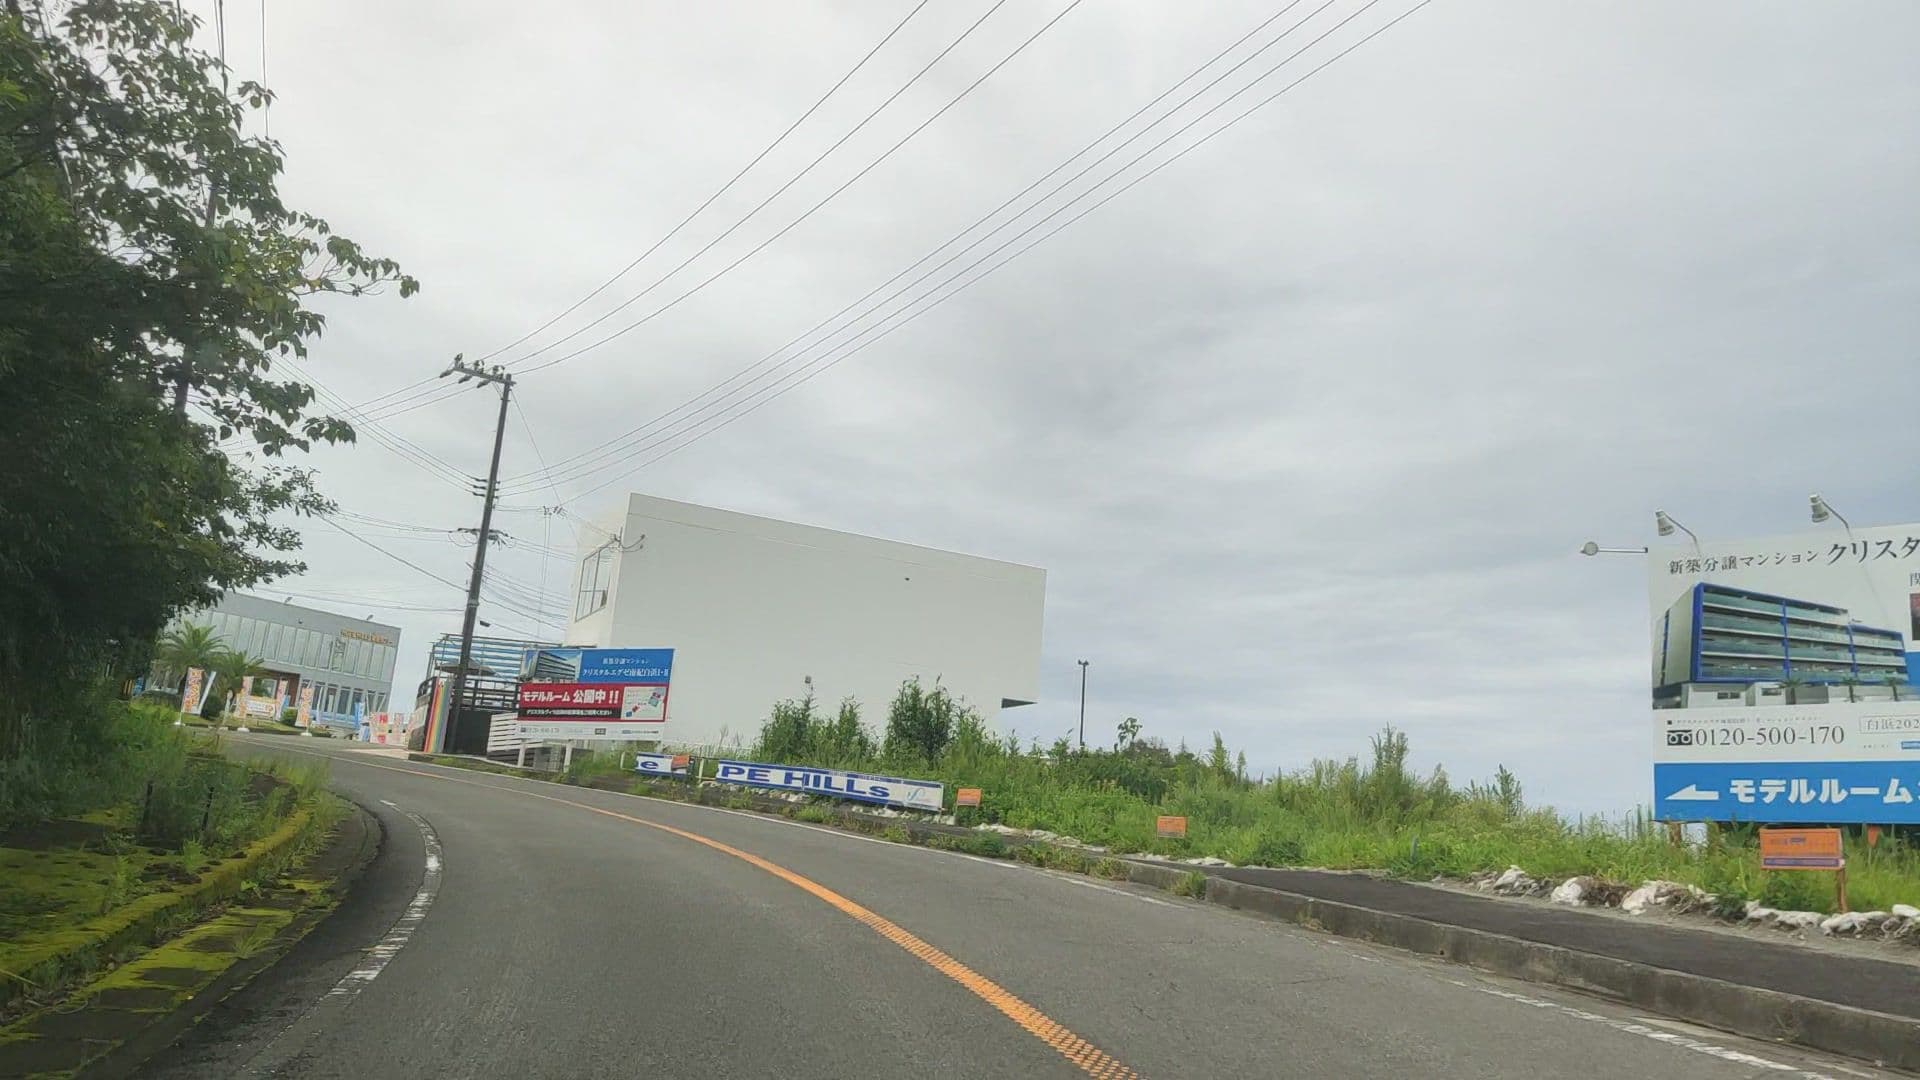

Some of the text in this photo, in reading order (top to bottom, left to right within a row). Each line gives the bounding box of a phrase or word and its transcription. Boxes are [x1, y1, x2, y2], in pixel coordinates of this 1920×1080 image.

[1669, 536, 1920, 575] 新築分譲マンション クリスタ
[522, 690, 571, 703] モデルルーム
[1696, 726, 1845, 746] 0120-500-170
[784, 772, 890, 798] HILLS
[1729, 778, 1920, 804] モデルルーム
